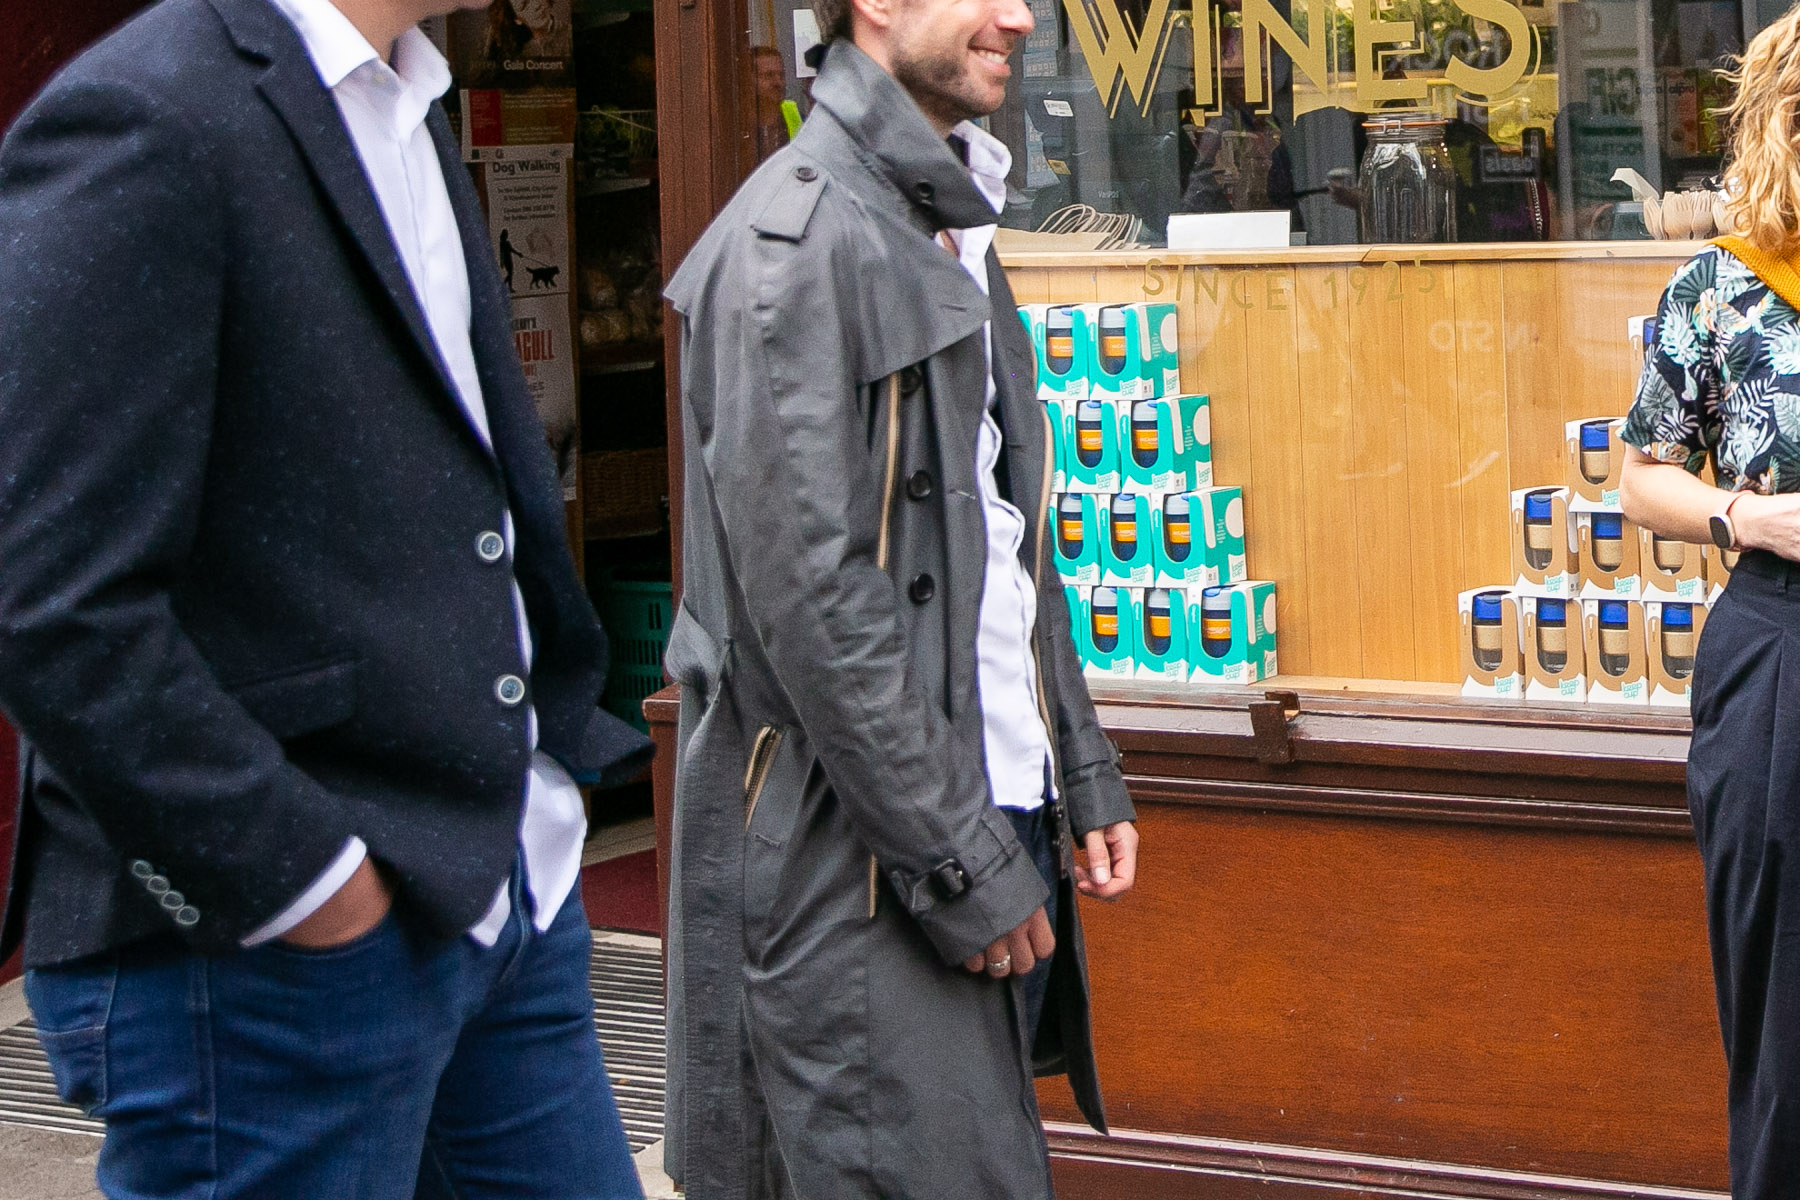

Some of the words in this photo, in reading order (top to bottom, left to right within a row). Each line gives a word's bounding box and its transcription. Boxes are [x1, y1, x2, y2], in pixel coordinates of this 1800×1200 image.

[493, 161, 515, 175] Dog
[518, 159, 560, 174] Walking
[1141, 258, 1287, 311] SINCE
[1323, 254, 1437, 308] 1925
